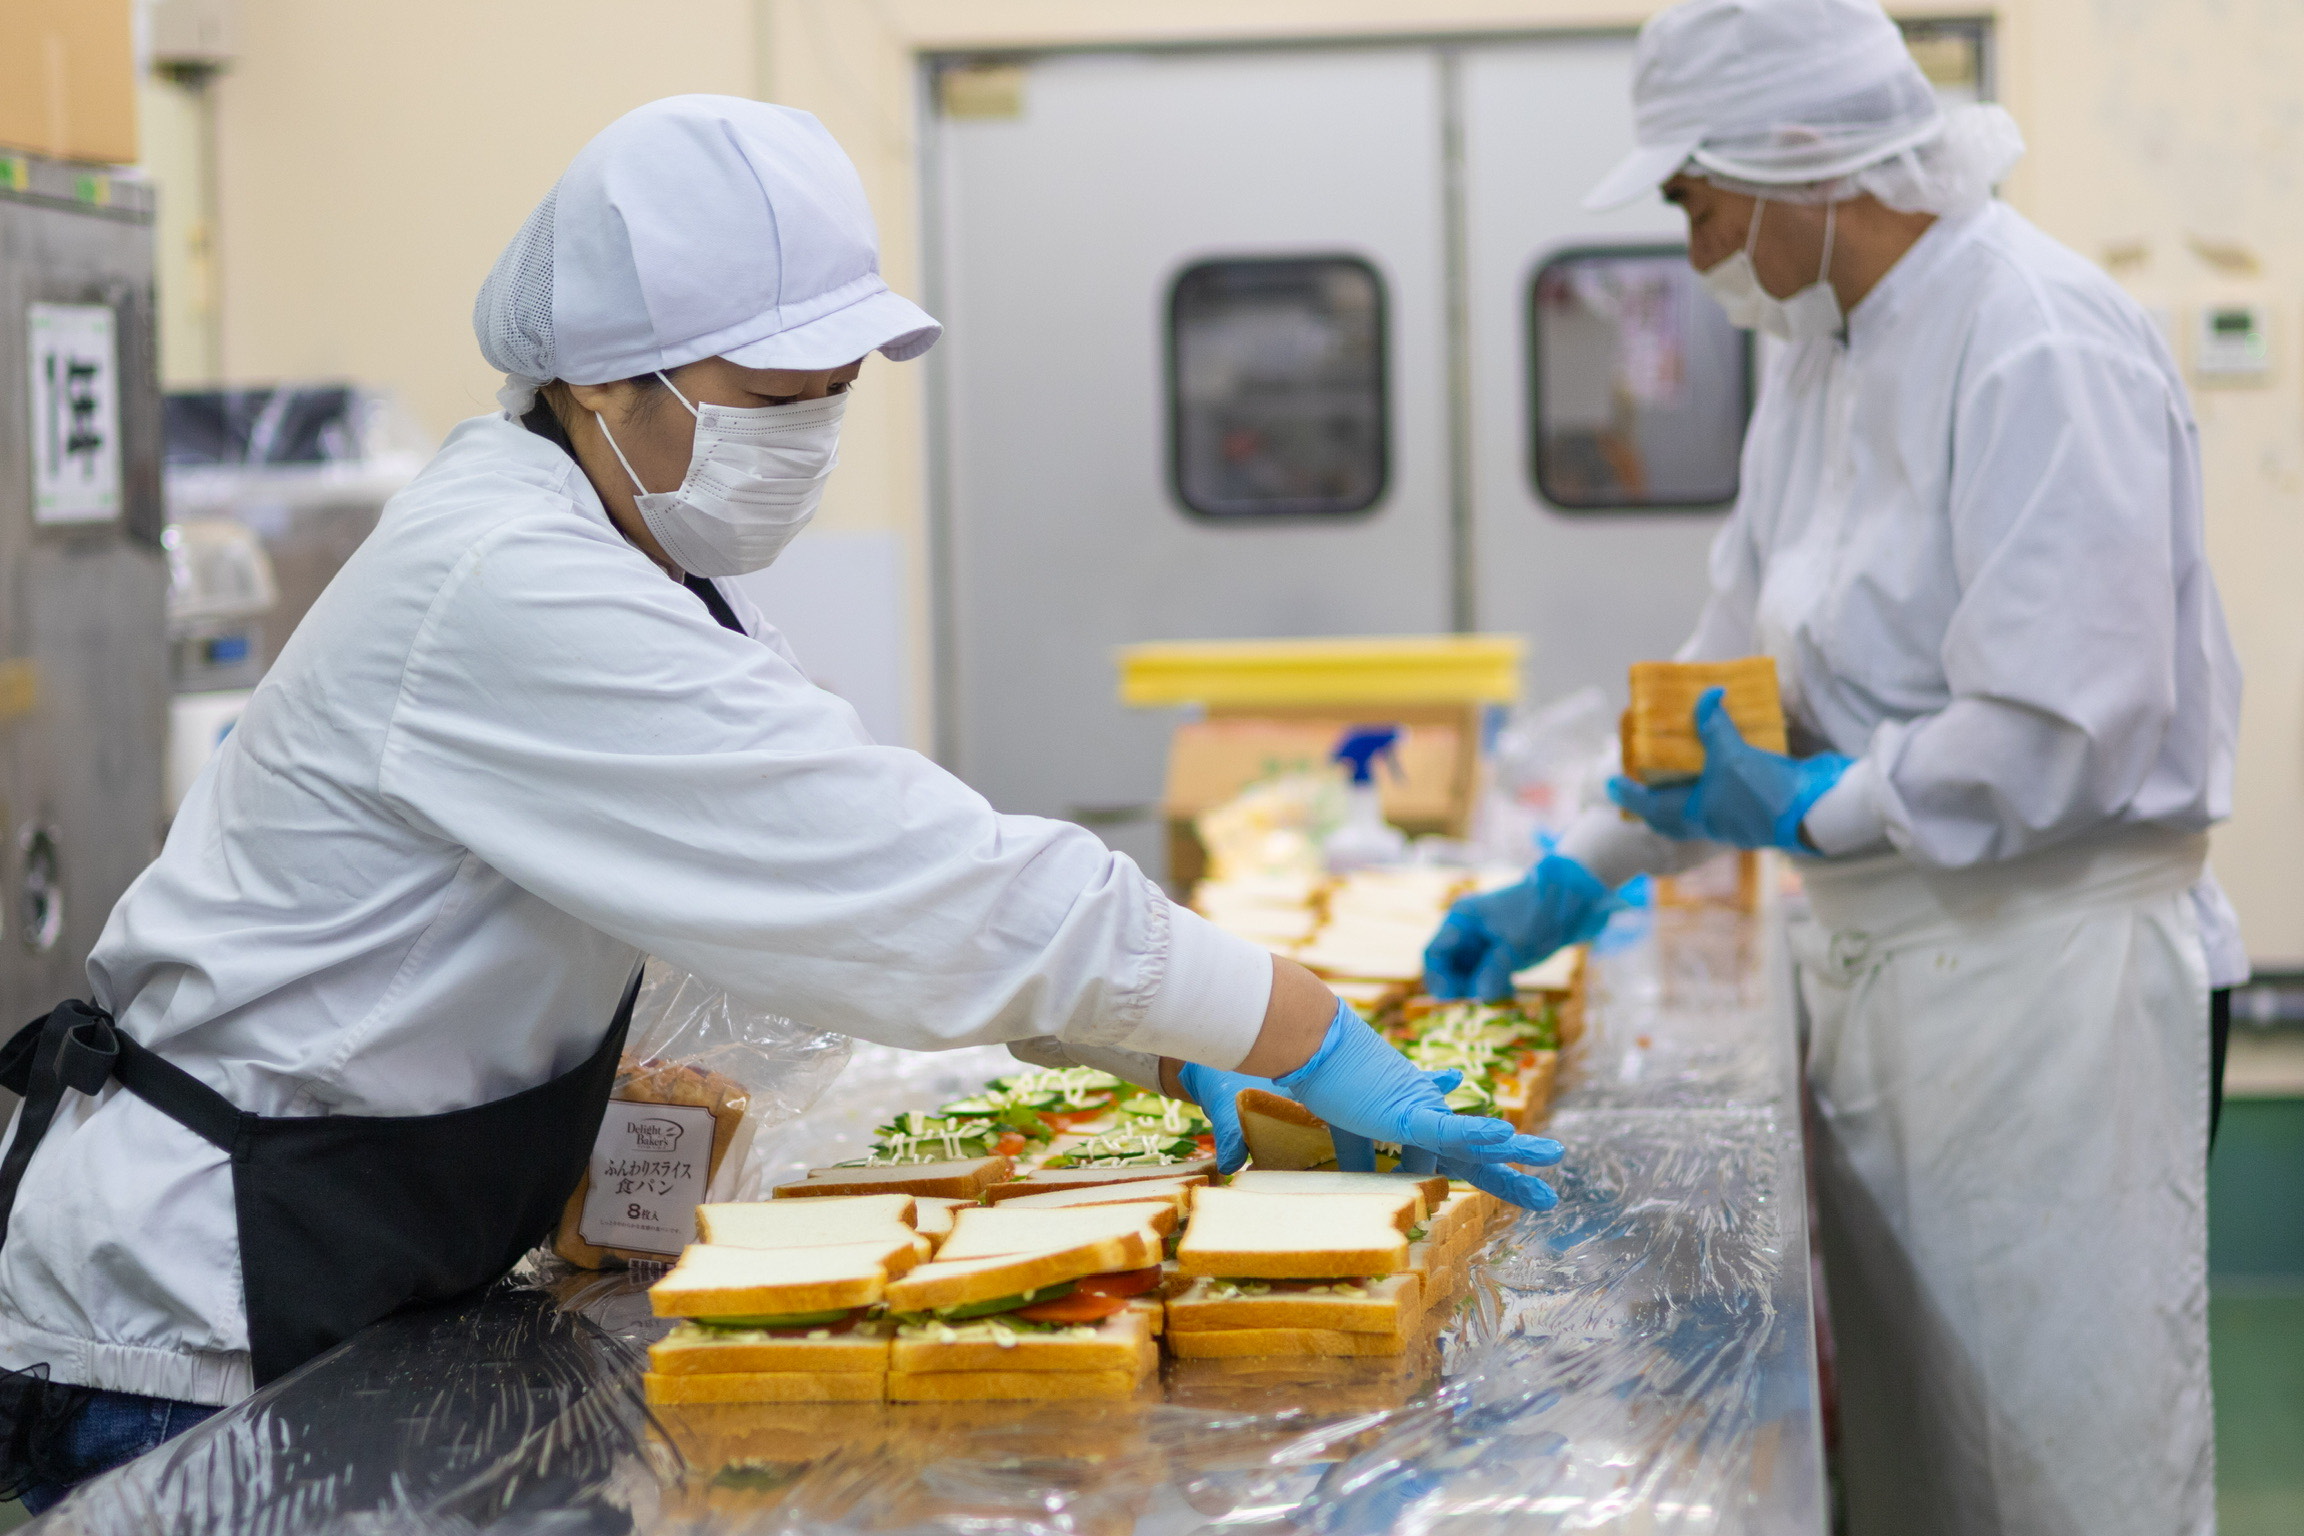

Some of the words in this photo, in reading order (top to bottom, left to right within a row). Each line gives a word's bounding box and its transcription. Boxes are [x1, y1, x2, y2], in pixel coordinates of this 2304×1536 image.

[627, 1122, 661, 1136] Delight
[637, 1134, 669, 1147] Baker's
[604, 1159, 692, 1179] ふんわりスライス
[615, 1178, 674, 1196] 食パン
